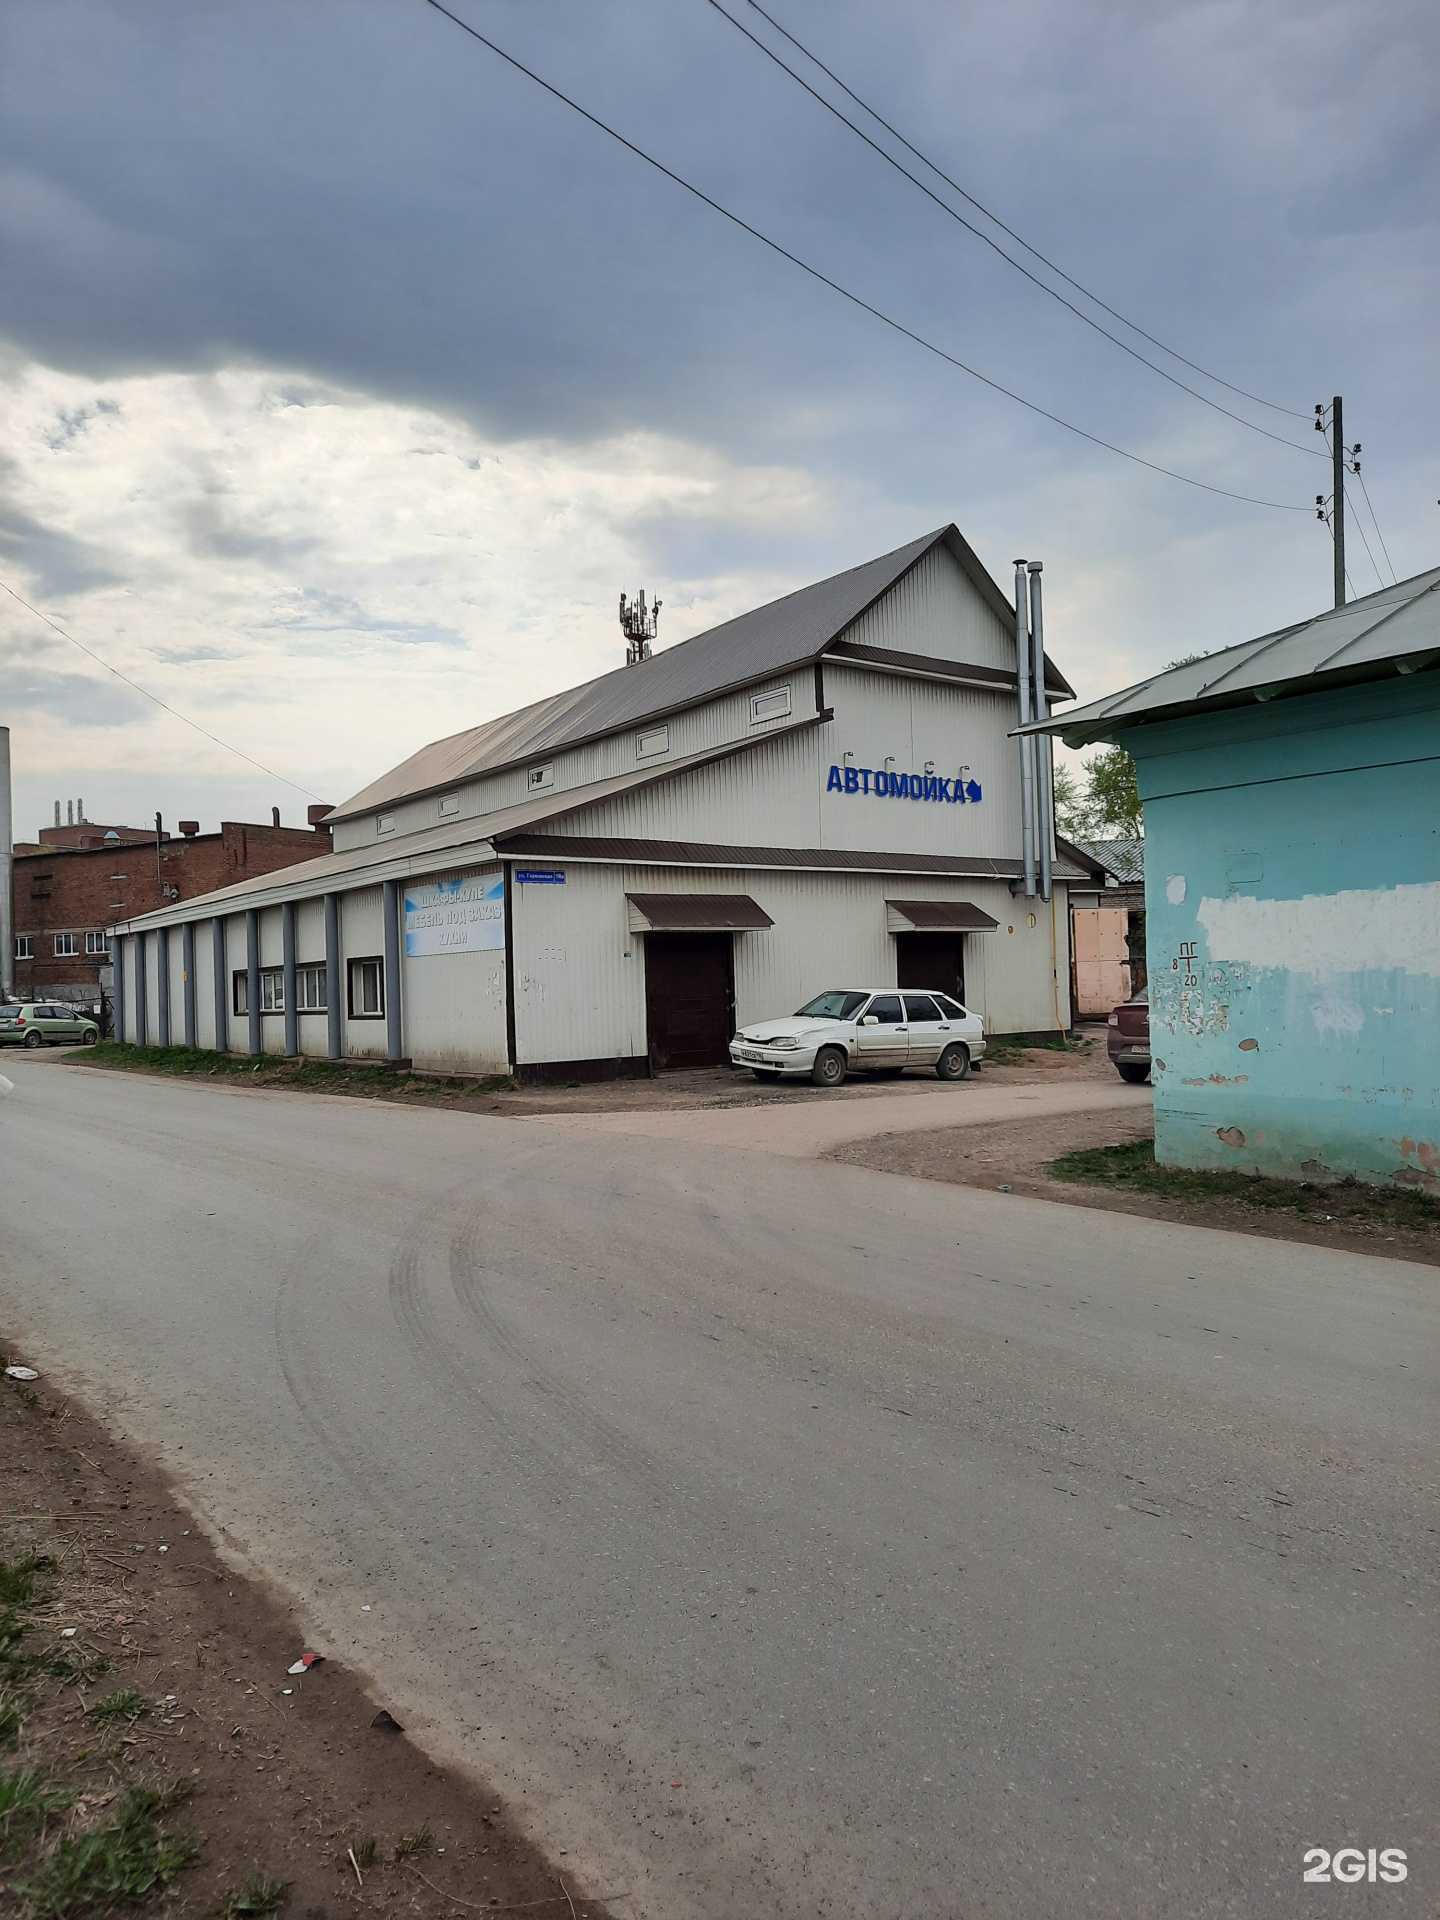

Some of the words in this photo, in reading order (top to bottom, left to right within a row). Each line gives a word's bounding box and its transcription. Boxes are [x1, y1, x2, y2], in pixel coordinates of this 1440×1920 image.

[826, 765, 966, 804] АВТОМОЙКА
[1180, 942, 1198, 955] ПГ
[1172, 958, 1178, 970] 8
[1184, 974, 1198, 987] 20
